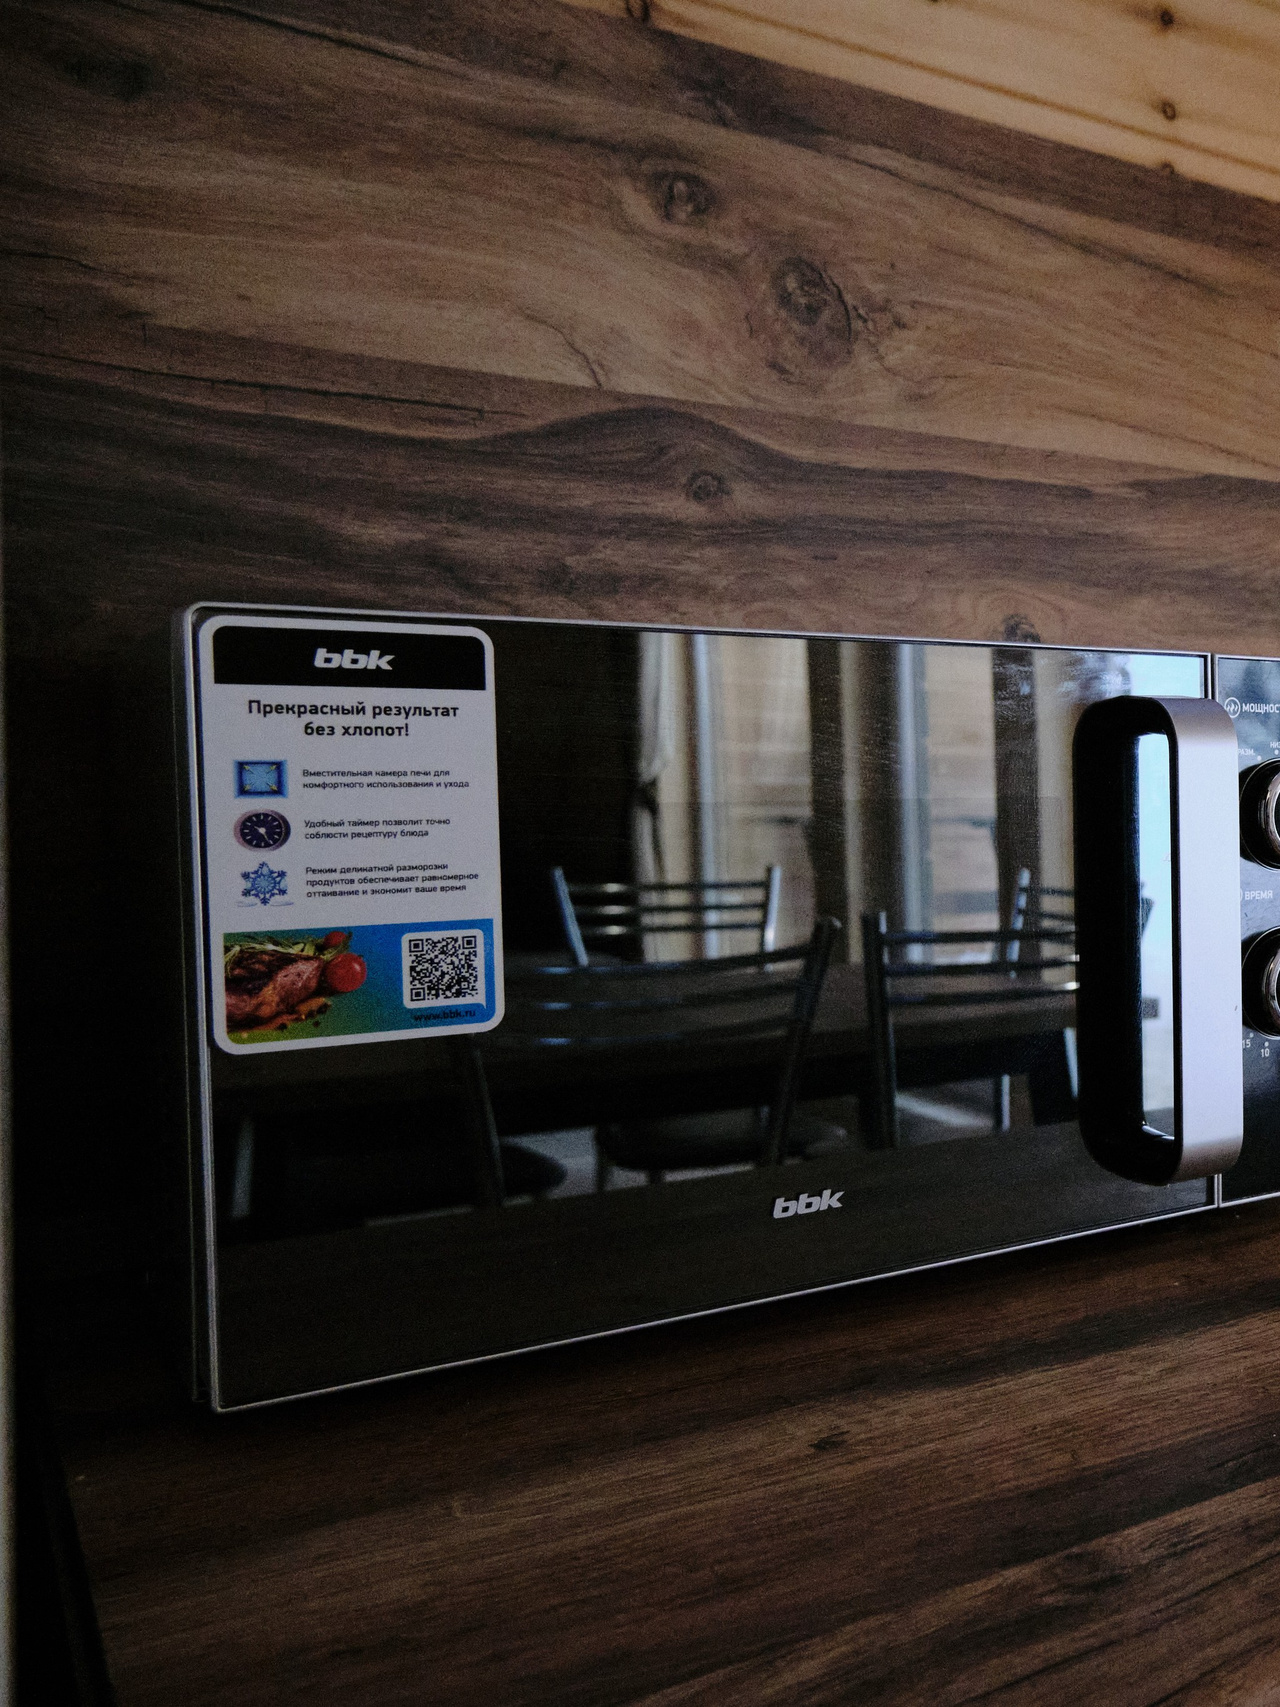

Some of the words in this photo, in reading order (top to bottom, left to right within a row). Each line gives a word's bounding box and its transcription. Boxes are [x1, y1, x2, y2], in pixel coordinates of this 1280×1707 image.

[313, 648, 396, 670] bbk
[248, 700, 366, 718] Прекрасный
[372, 703, 459, 719] результат
[304, 723, 335, 736] без
[341, 723, 410, 737] хлопот!
[302, 769, 373, 777] Вместительная
[375, 770, 408, 778] камера
[433, 770, 450, 778] для
[302, 781, 364, 790] комфортного
[443, 781, 470, 790] ухода
[304, 819, 345, 828] Удобный
[347, 818, 380, 828] таймер
[382, 818, 423, 826] позволит
[304, 831, 349, 840] соблюсти
[351, 830, 398, 840] рецептуру
[400, 829, 429, 838] блюда
[305, 866, 337, 875] Режим
[339, 864, 394, 874] деликатной
[396, 864, 448, 873] разморозки
[306, 878, 356, 888] продуктов
[358, 875, 419, 885] обеспечивает
[421, 873, 479, 884] равномерное
[306, 889, 360, 898] оттаивание
[370, 887, 412, 896] экономит
[414, 885, 438, 893] ваше
[440, 884, 466, 893] время
[1244, 890, 1273, 900] ВРЕМЯ
[413, 1009, 476, 1022] www.bbk.ru
[1260, 1048, 1270, 1058] 10
[773, 1189, 845, 1219] bbk
